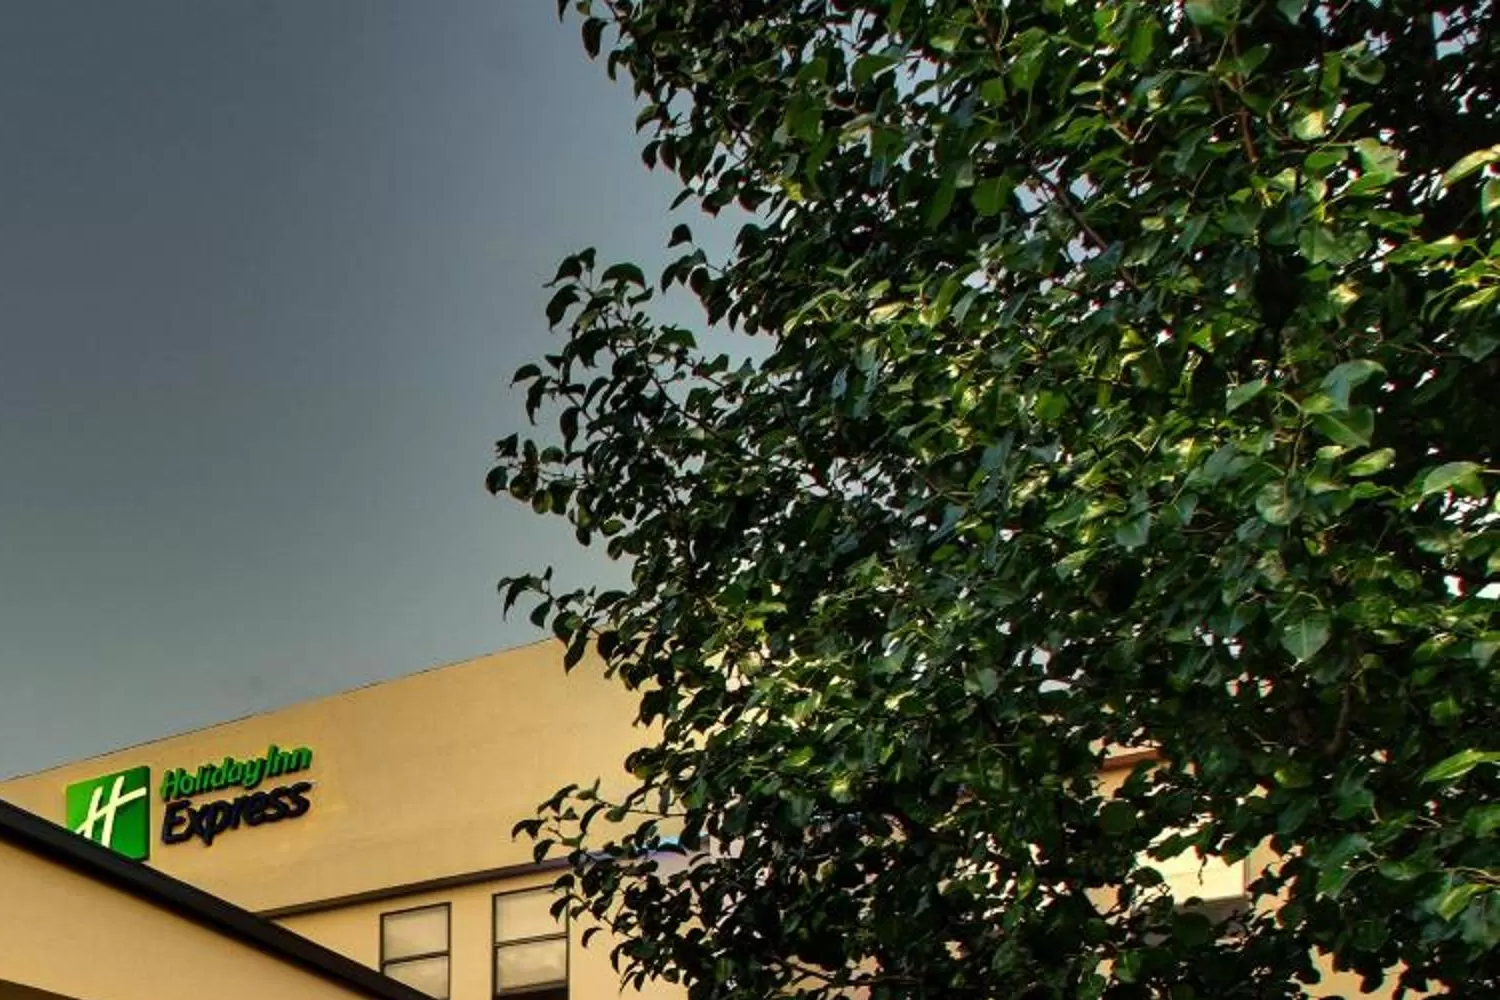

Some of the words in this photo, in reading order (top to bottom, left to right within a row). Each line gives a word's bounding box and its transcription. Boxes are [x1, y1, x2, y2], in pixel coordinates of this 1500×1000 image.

[160, 756, 267, 802] Holiday
[265, 744, 313, 778] Inn
[161, 781, 313, 847] Express
